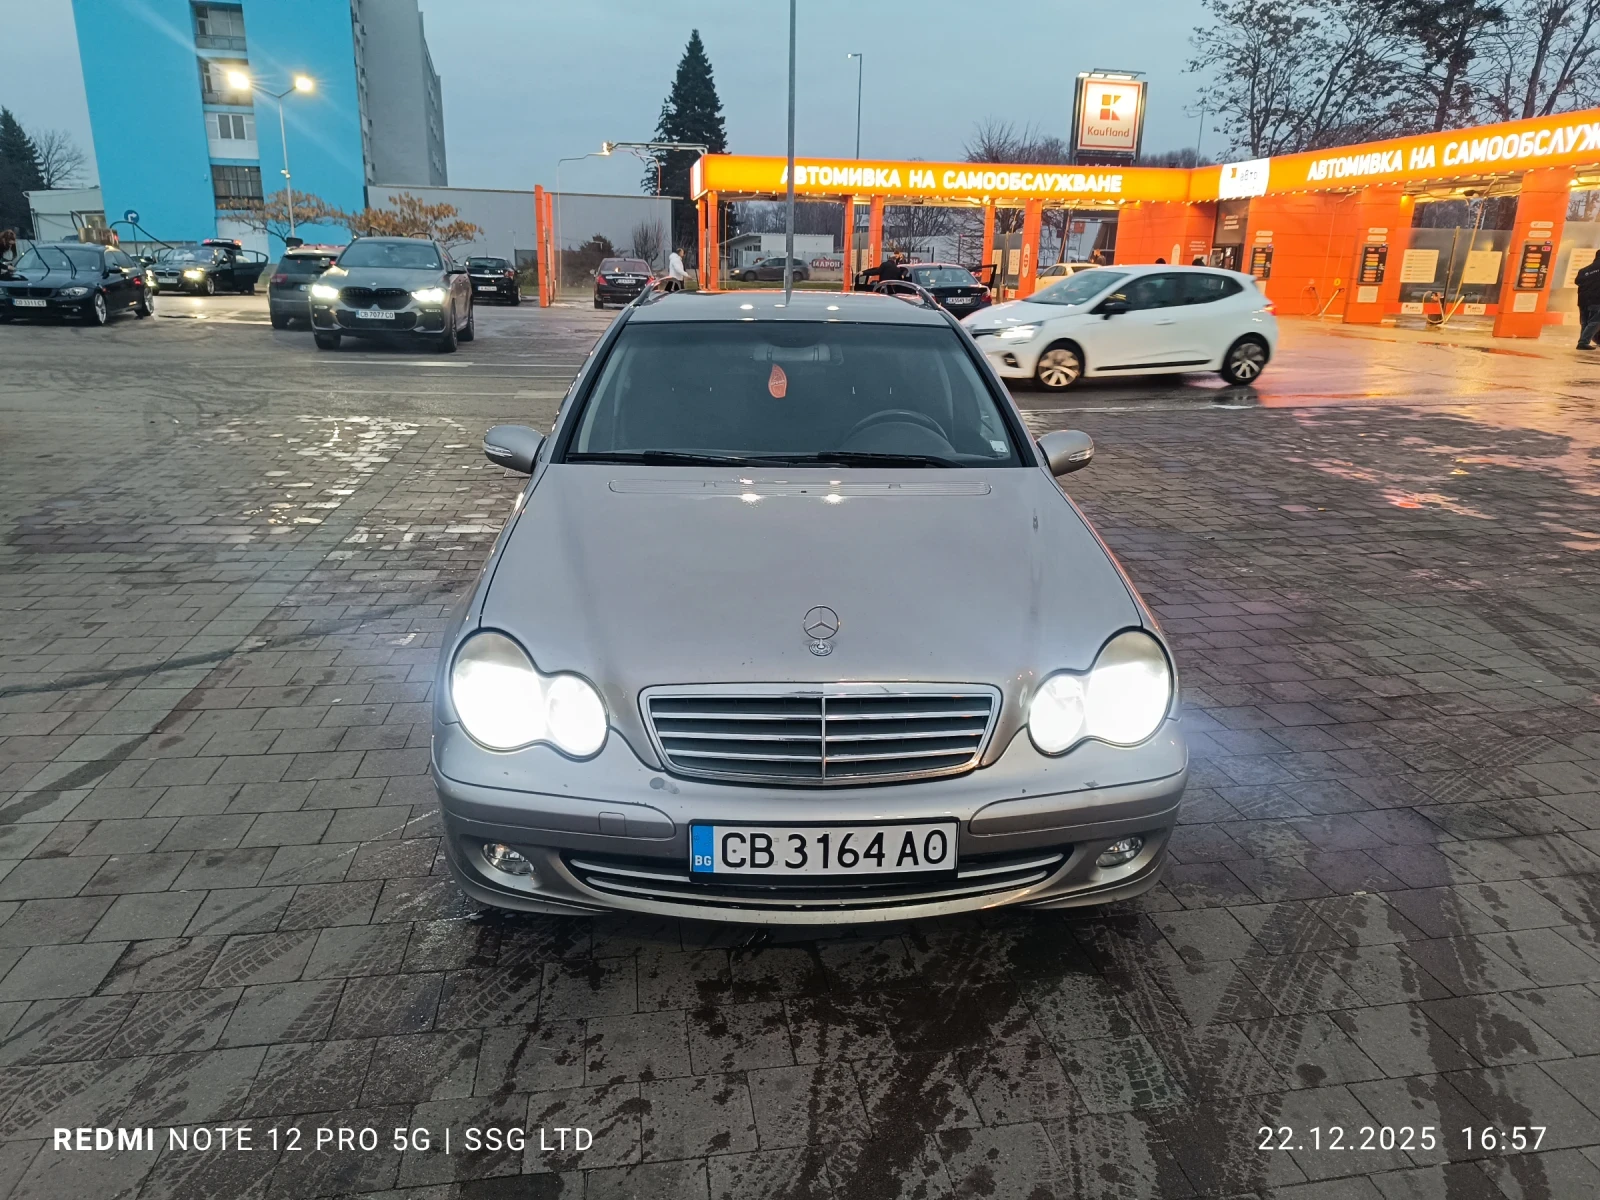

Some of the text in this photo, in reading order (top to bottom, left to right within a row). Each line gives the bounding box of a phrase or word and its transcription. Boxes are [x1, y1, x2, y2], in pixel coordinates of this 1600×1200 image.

[1087, 126, 1130, 138] Kaufland
[1306, 121, 1600, 182] АВТОМИВКА НА САМООБСЛУЖ
[909, 169, 936, 189] НА
[943, 170, 1123, 193] САМООБСЛУЖВАНЕ
[695, 855, 712, 867] BG
[721, 832, 775, 869] CB
[784, 831, 886, 869] 3164
